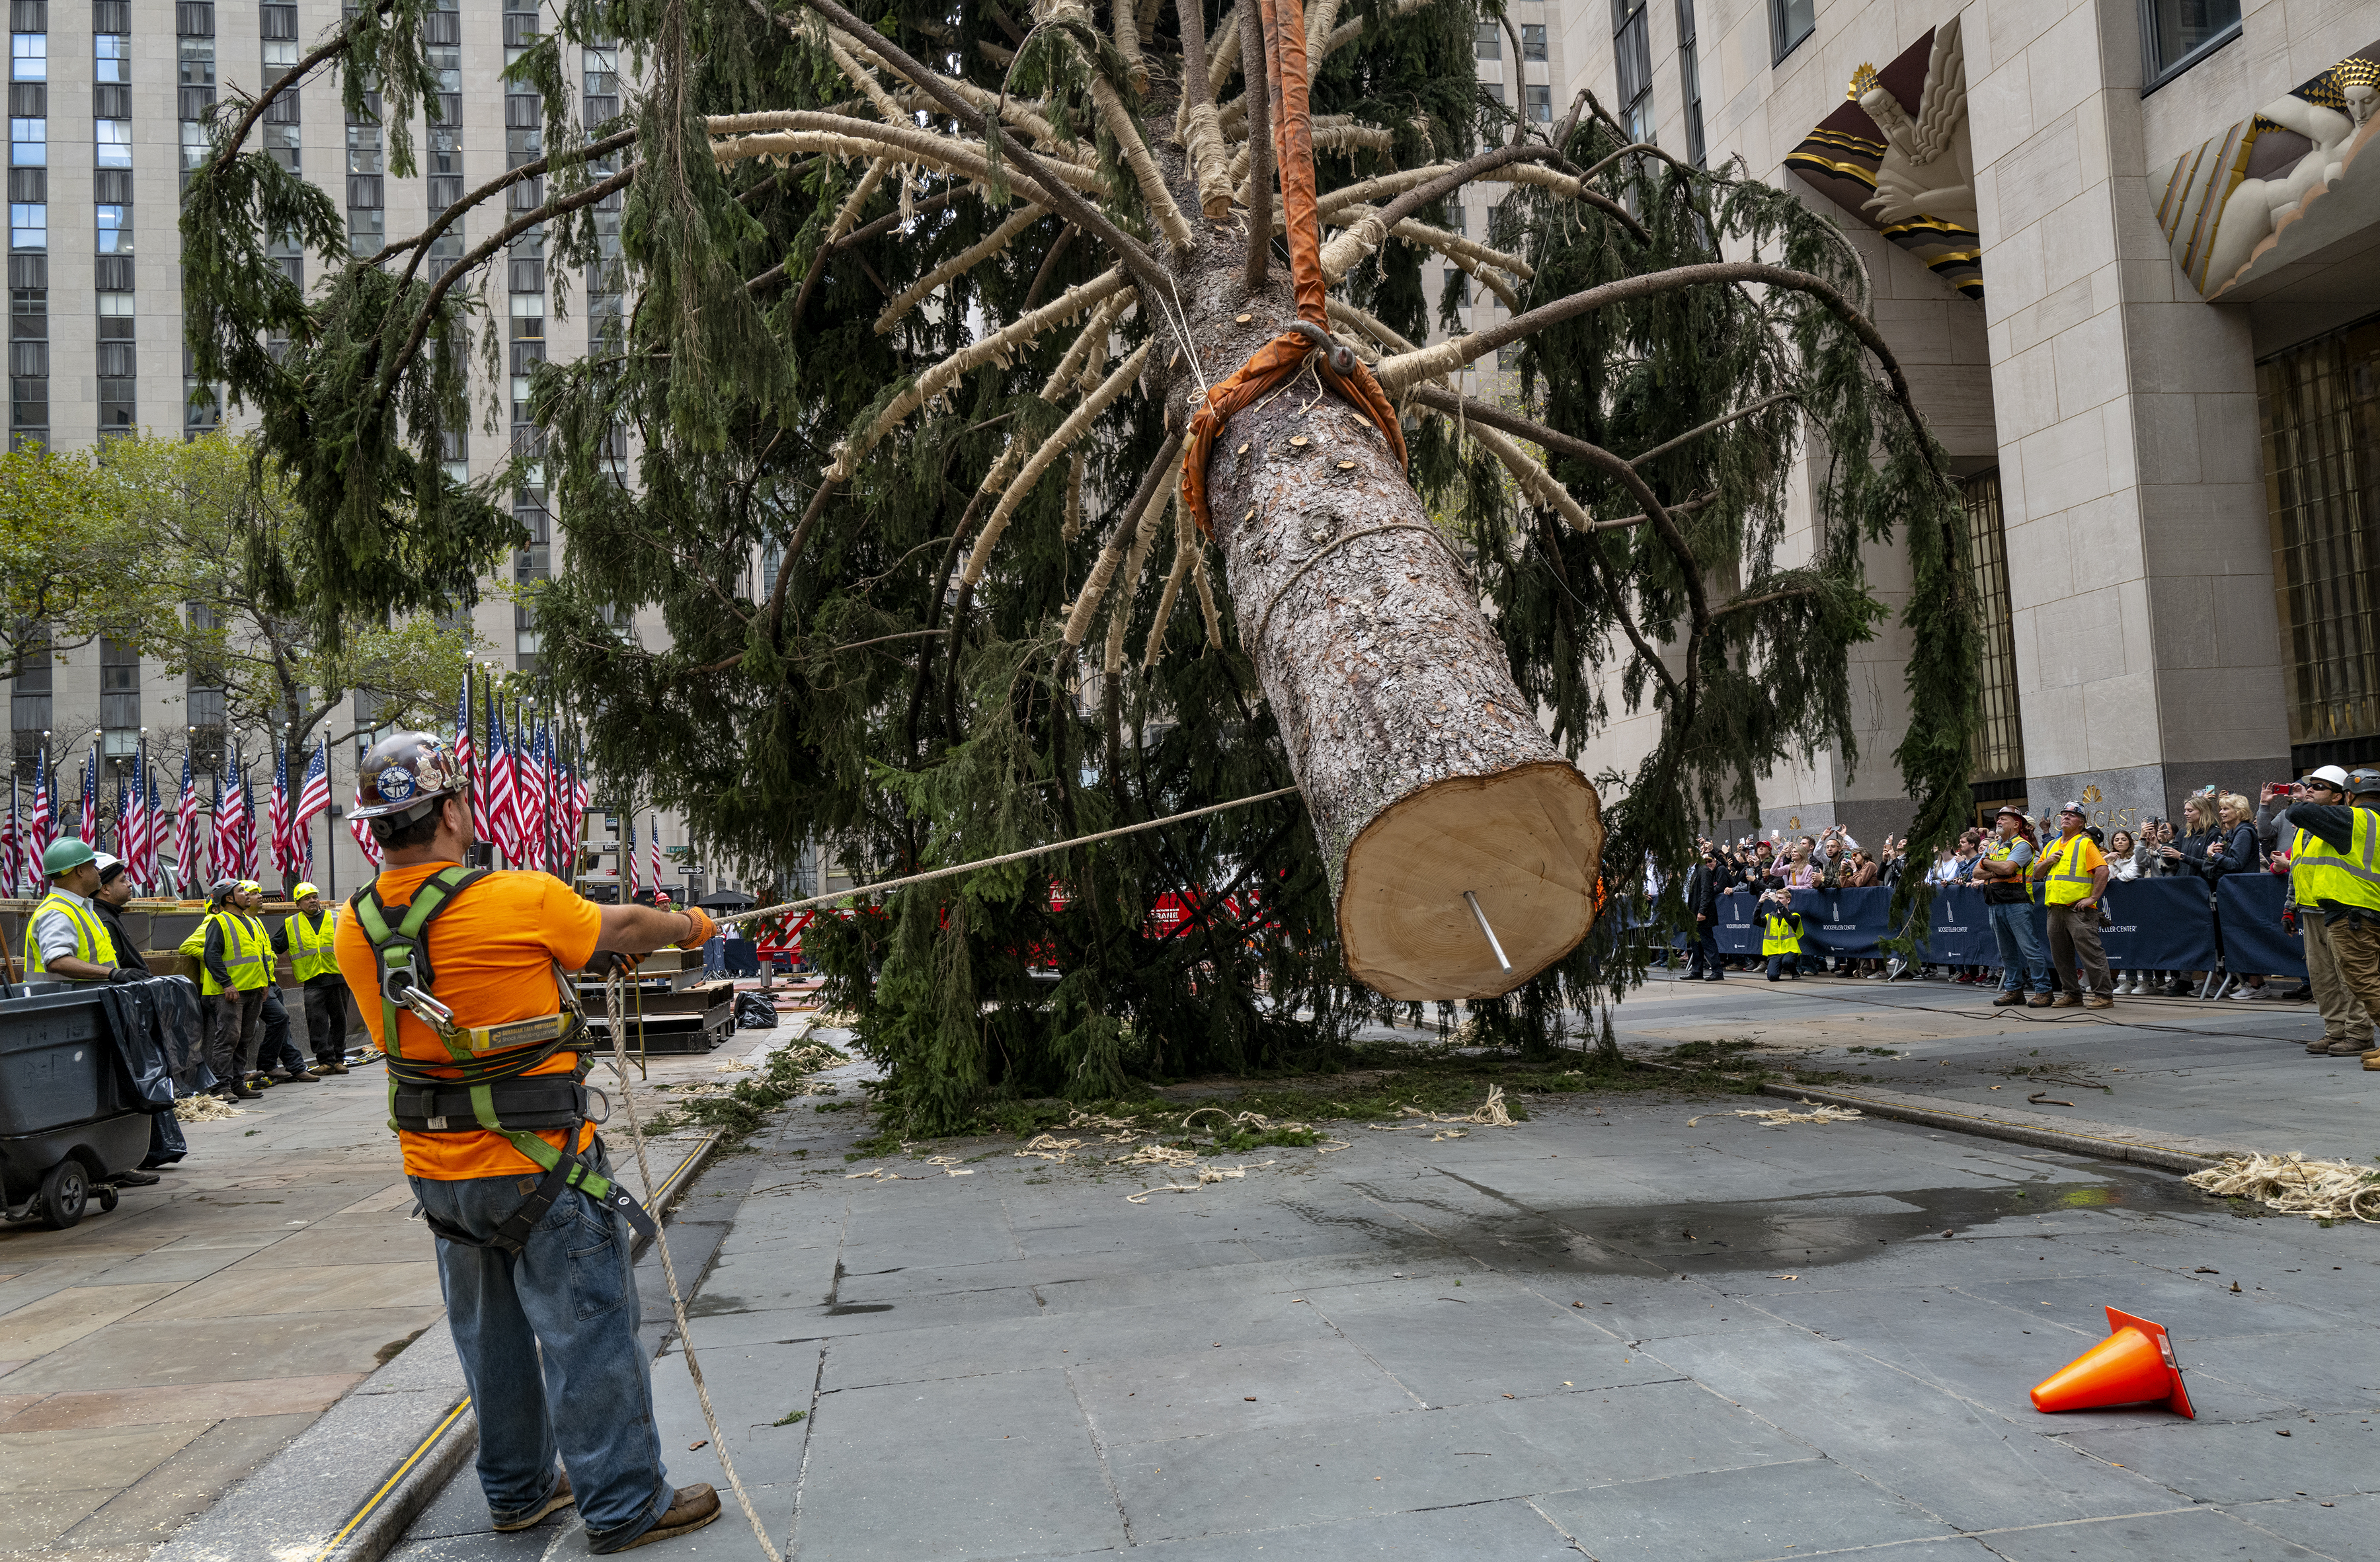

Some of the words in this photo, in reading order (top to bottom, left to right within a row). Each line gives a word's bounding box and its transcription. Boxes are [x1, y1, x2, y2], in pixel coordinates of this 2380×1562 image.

[379, 767, 397, 779] WORKERS
[399, 767, 411, 777] LOCAL
[2053, 808, 2137, 831] CCAST
[502, 1027, 523, 1036] GUARDIAN
[534, 1021, 557, 1031] PROTECTION
